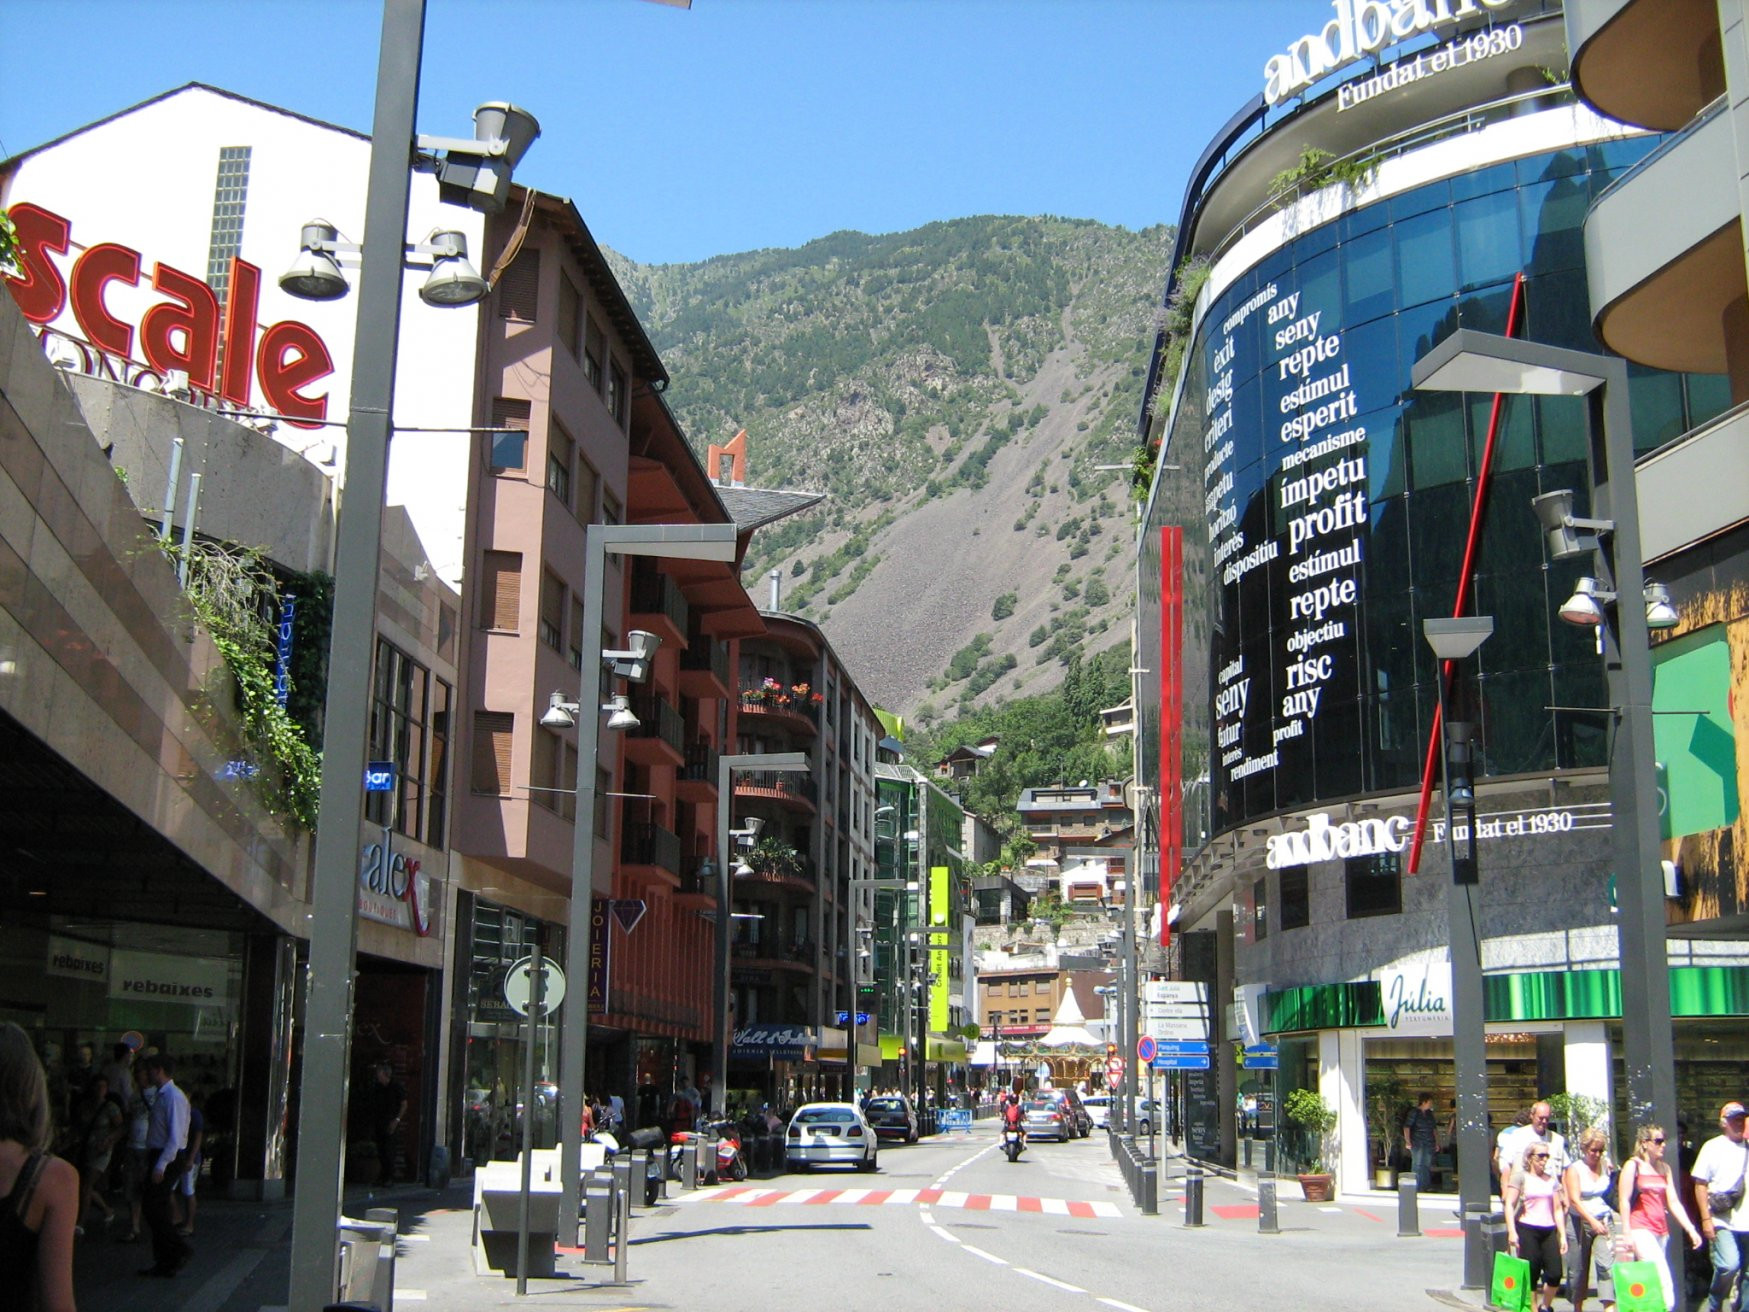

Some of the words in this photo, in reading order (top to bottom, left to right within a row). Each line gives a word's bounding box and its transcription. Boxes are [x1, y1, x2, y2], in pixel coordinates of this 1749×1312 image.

[1337, 53, 1426, 113] Fundat
[1431, 41, 1457, 71] el
[1456, 24, 1523, 67] 1930
[1223, 282, 1278, 335] compromís
[1268, 291, 1300, 325] any
[1275, 311, 1321, 350] seny
[1279, 335, 1340, 380] repte
[1206, 368, 1234, 416] desig
[1280, 363, 1350, 413] estímul
[1204, 402, 1233, 453] criteri
[1280, 390, 1357, 443] esperit
[1204, 440, 1234, 488] producte
[1282, 426, 1366, 471] mecanisme
[1280, 457, 1366, 509] ímpetu
[1288, 490, 1367, 556] profit
[1213, 530, 1244, 568] interès
[1223, 539, 1279, 586] dispositiu
[1288, 538, 1361, 584] estímul
[1289, 577, 1356, 621] repte
[1286, 620, 1345, 653] objectiu
[1218, 654, 1243, 686] capital
[1286, 653, 1333, 690] risc
[1215, 677, 1251, 720] seny
[1282, 686, 1323, 719] any
[1272, 719, 1304, 747] profit
[1230, 747, 1279, 783] rendiment
[1266, 813, 1410, 870] andbanc
[1506, 815, 1525, 836] el
[1529, 812, 1572, 834] 1930
[361, 827, 431, 937] alex
[53, 954, 104, 974] rebaixes
[590, 901, 604, 997] JOIERIA
[123, 979, 213, 998] rebaixes
[1389, 974, 1446, 1030] Júlia
